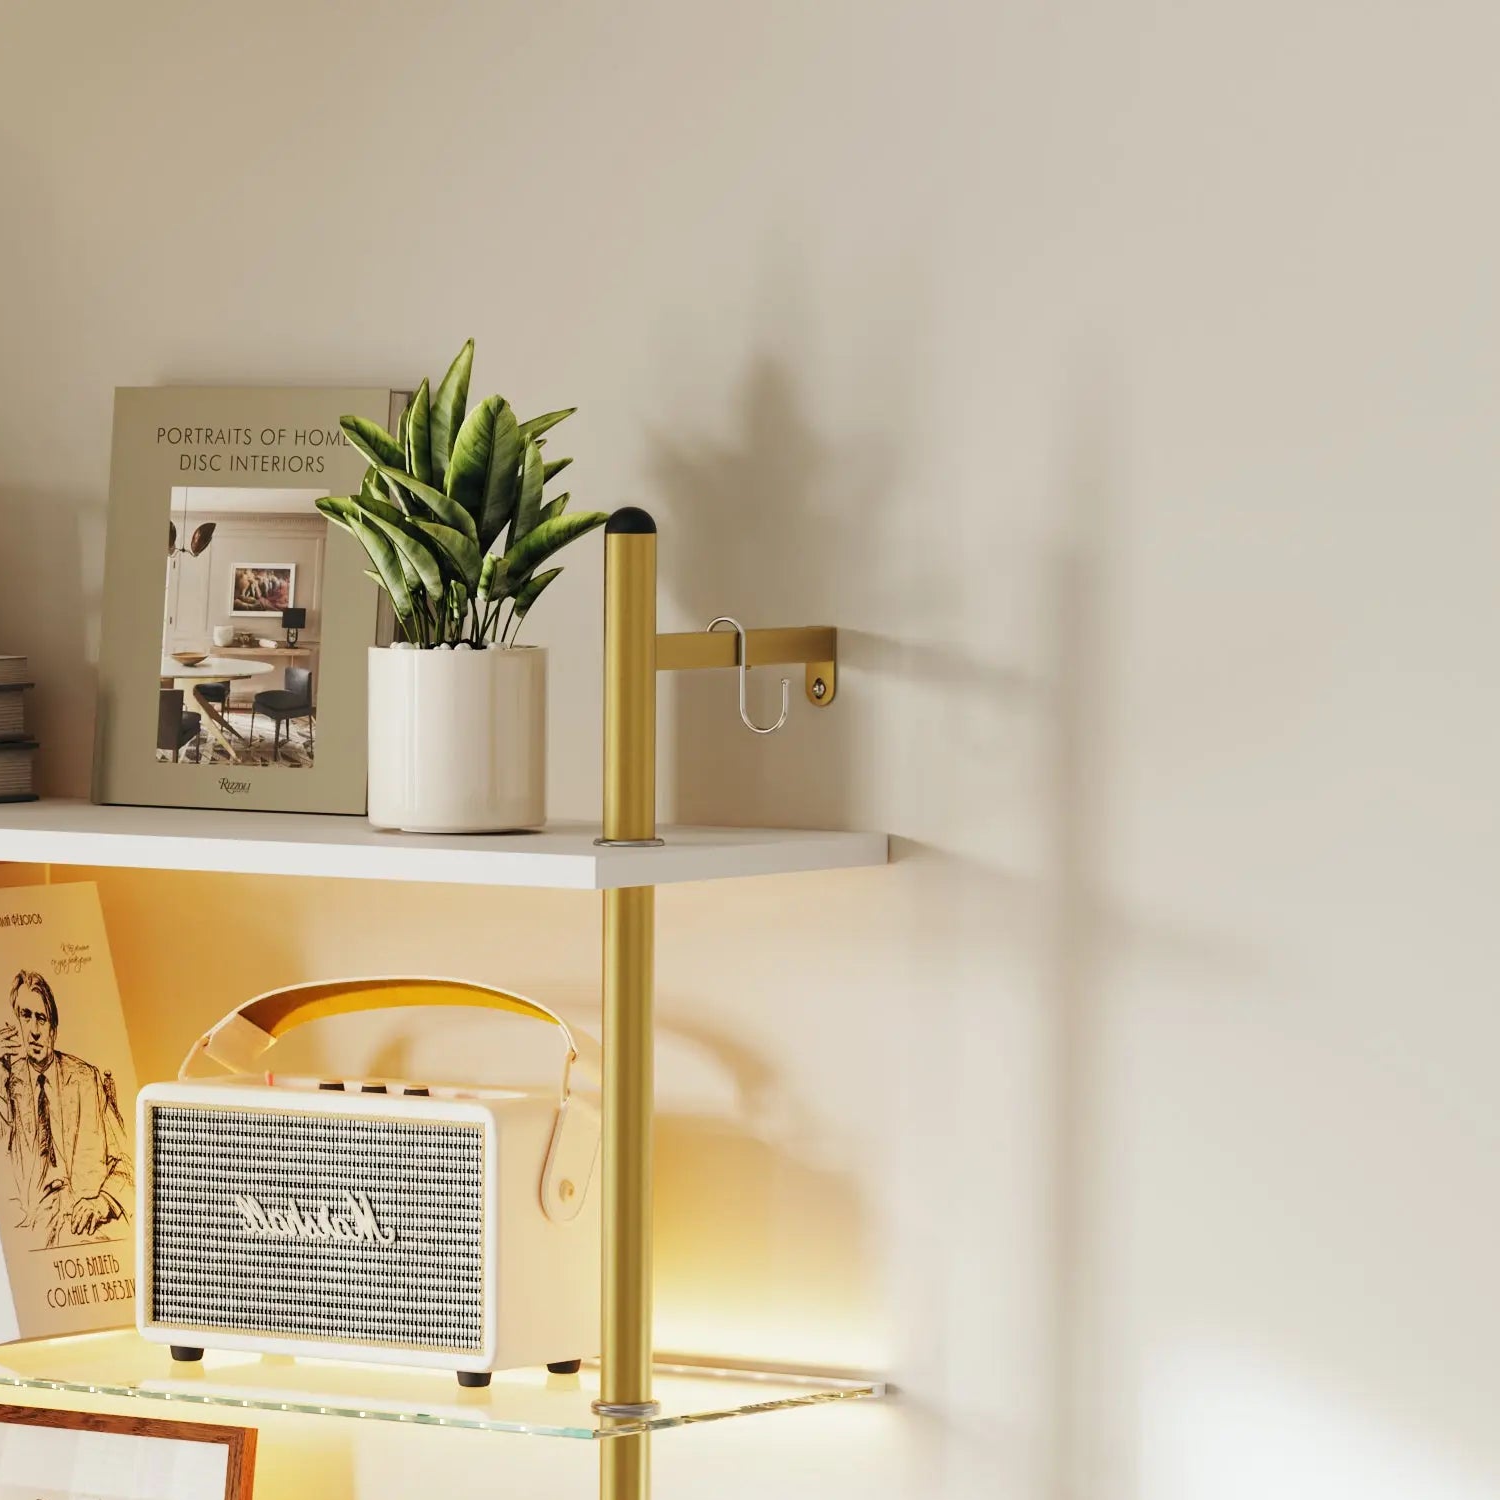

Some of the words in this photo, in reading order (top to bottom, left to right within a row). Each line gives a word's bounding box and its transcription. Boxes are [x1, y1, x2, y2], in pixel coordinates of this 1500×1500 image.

[156, 427, 252, 446] PORTRAITS
[260, 428, 287, 446] OF
[179, 455, 221, 472] DISC
[230, 455, 325, 473] INTERIORS
